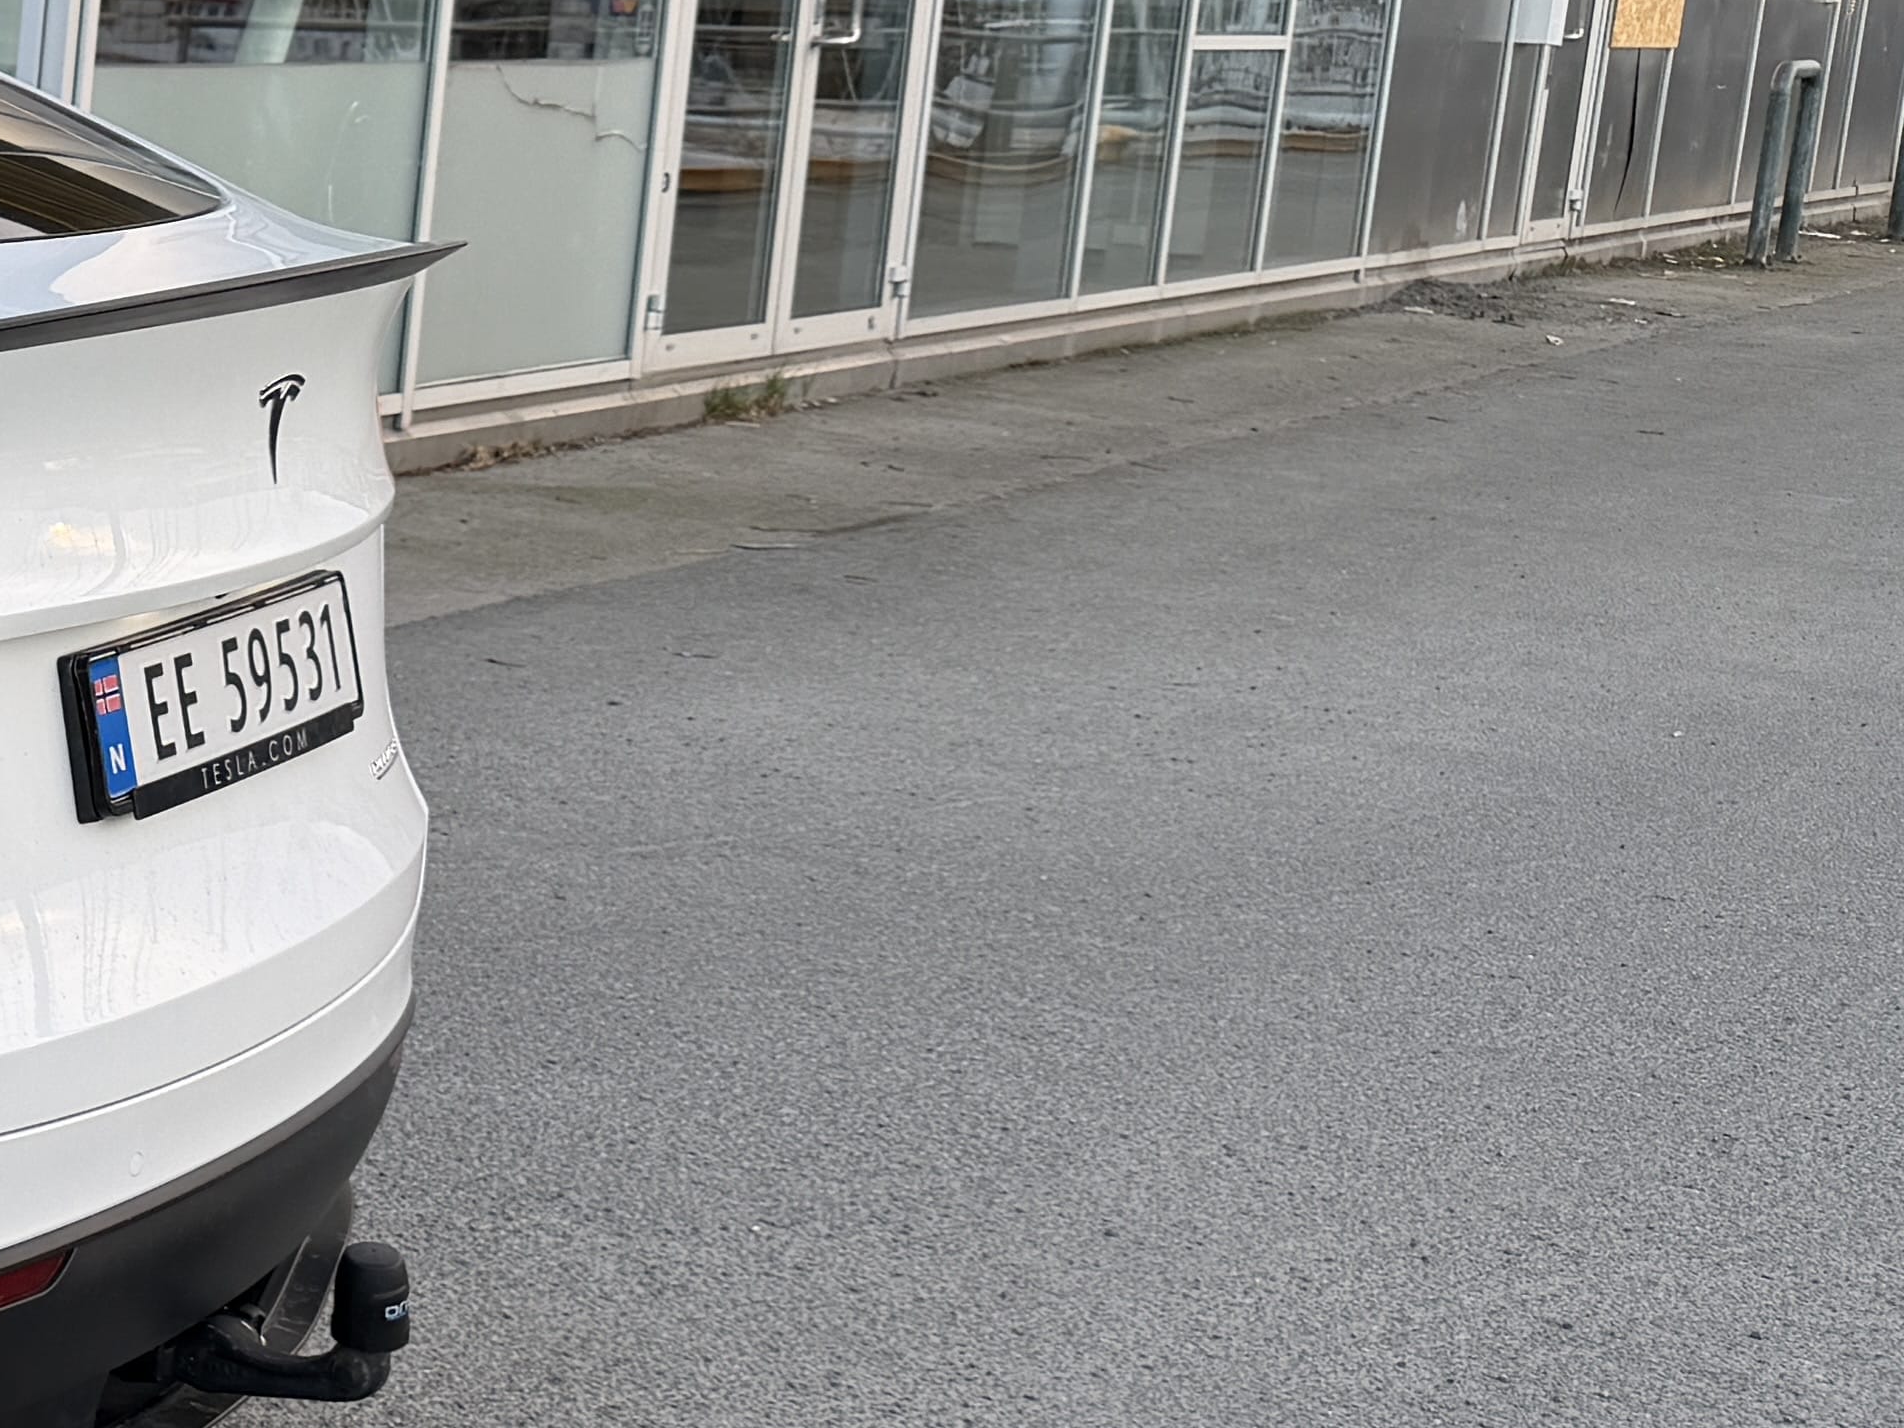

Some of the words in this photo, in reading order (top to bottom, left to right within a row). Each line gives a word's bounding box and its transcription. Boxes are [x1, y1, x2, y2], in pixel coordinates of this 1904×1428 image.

[143, 652, 206, 761] EE
[220, 603, 344, 735] 59531
[108, 743, 128, 775] N
[200, 728, 310, 791] TESLA.COM
